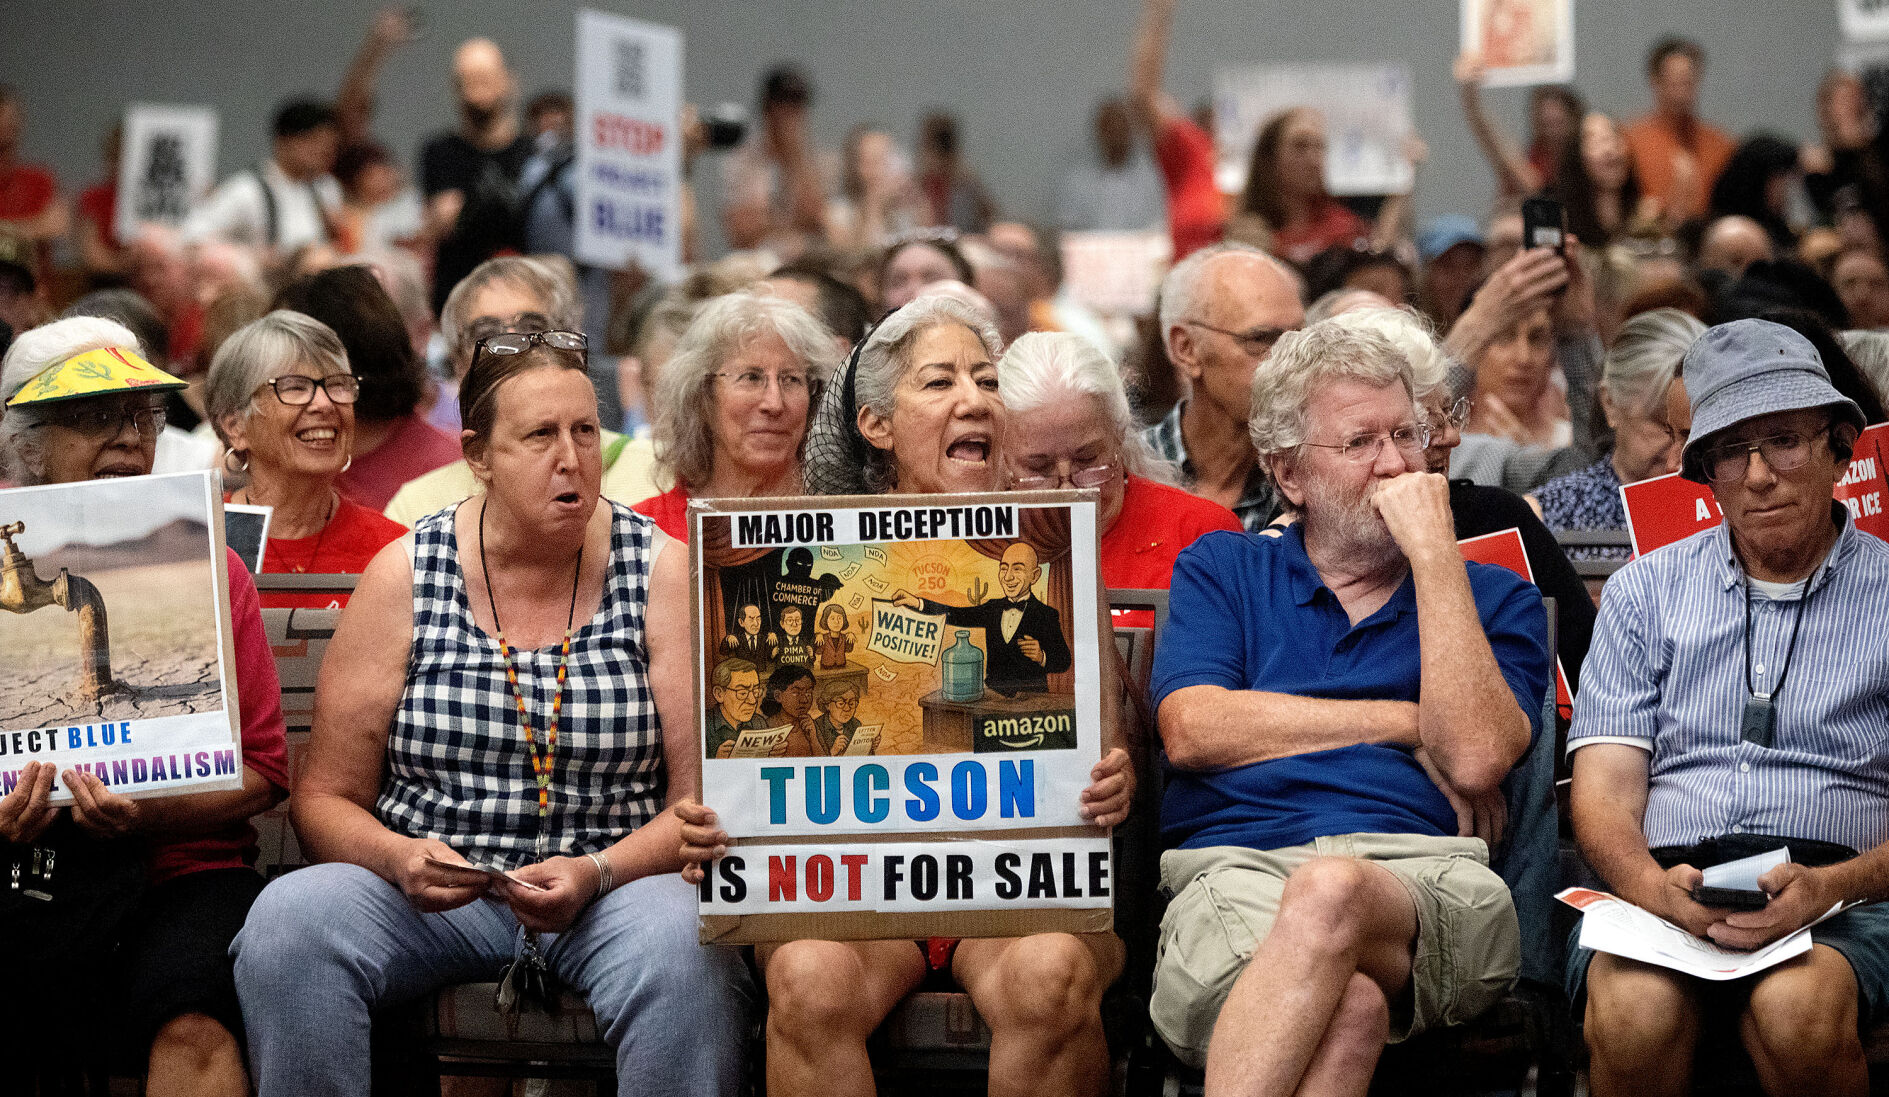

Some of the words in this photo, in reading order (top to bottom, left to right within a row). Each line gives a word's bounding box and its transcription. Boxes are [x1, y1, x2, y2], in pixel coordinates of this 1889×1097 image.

[1837, 457, 1877, 487] AZON
[1861, 491, 1882, 517] ICE
[738, 512, 834, 545] MAJOR
[858, 506, 1014, 541] DECEPTION
[823, 549, 839, 558] NDA
[868, 549, 884, 561] NDA
[912, 562, 950, 578] TUCSON
[775, 581, 812, 595] CHAMBER
[918, 576, 946, 590] 250
[772, 591, 818, 607] COMMERCE
[877, 610, 939, 641] WATER
[784, 646, 804, 654] PIMA
[873, 632, 936, 659] POSITIVE!
[780, 655, 809, 664] COUNTY
[983, 713, 1071, 739] amazon
[0, 729, 58, 756] JECT
[67, 722, 132, 749] BLUE
[740, 732, 785, 748] NEWS
[760, 759, 1036, 825] TUCSON
[701, 855, 747, 903] IS
[768, 854, 868, 903] NOT
[883, 853, 974, 901] FOR
[994, 851, 1110, 900] SALE
